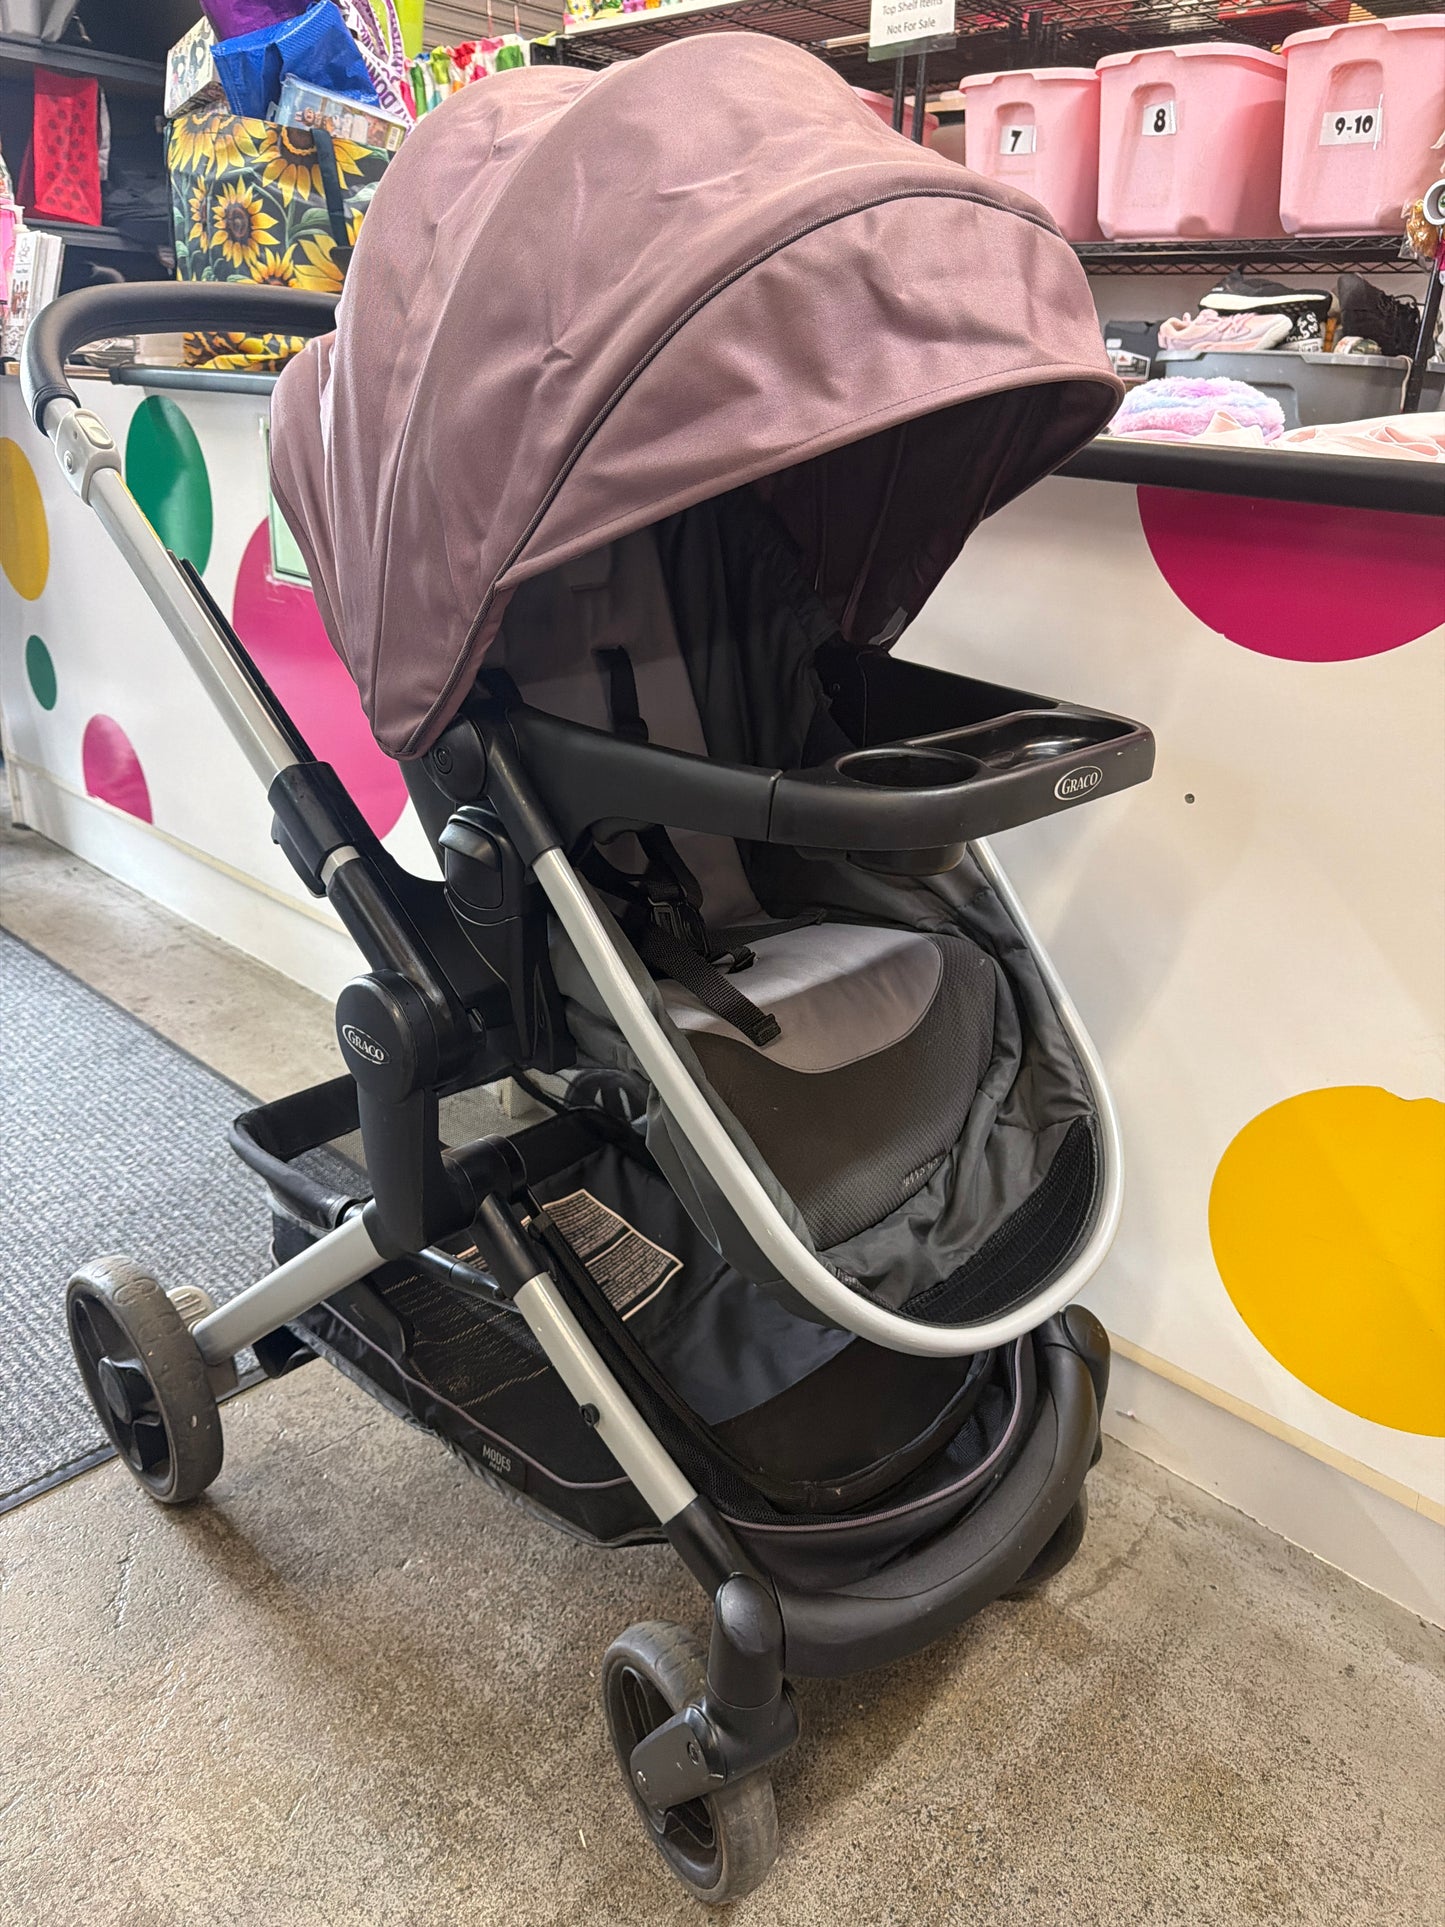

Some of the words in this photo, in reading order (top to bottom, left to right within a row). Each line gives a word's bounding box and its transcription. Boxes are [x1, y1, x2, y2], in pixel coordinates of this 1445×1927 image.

[882, 5, 897, 16] Top
[898, 0, 918, 12] Shelf
[886, 24, 902, 35] Not
[903, 21, 917, 32] For
[918, 17, 936, 29] Sale
[1153, 108, 1167, 133] 8
[1335, 115, 1374, 136] 9-10
[1010, 130, 1023, 152] 7
[1061, 771, 1099, 795] GRACO
[347, 1030, 385, 1061] GRACO
[482, 1444, 512, 1472] MODES
